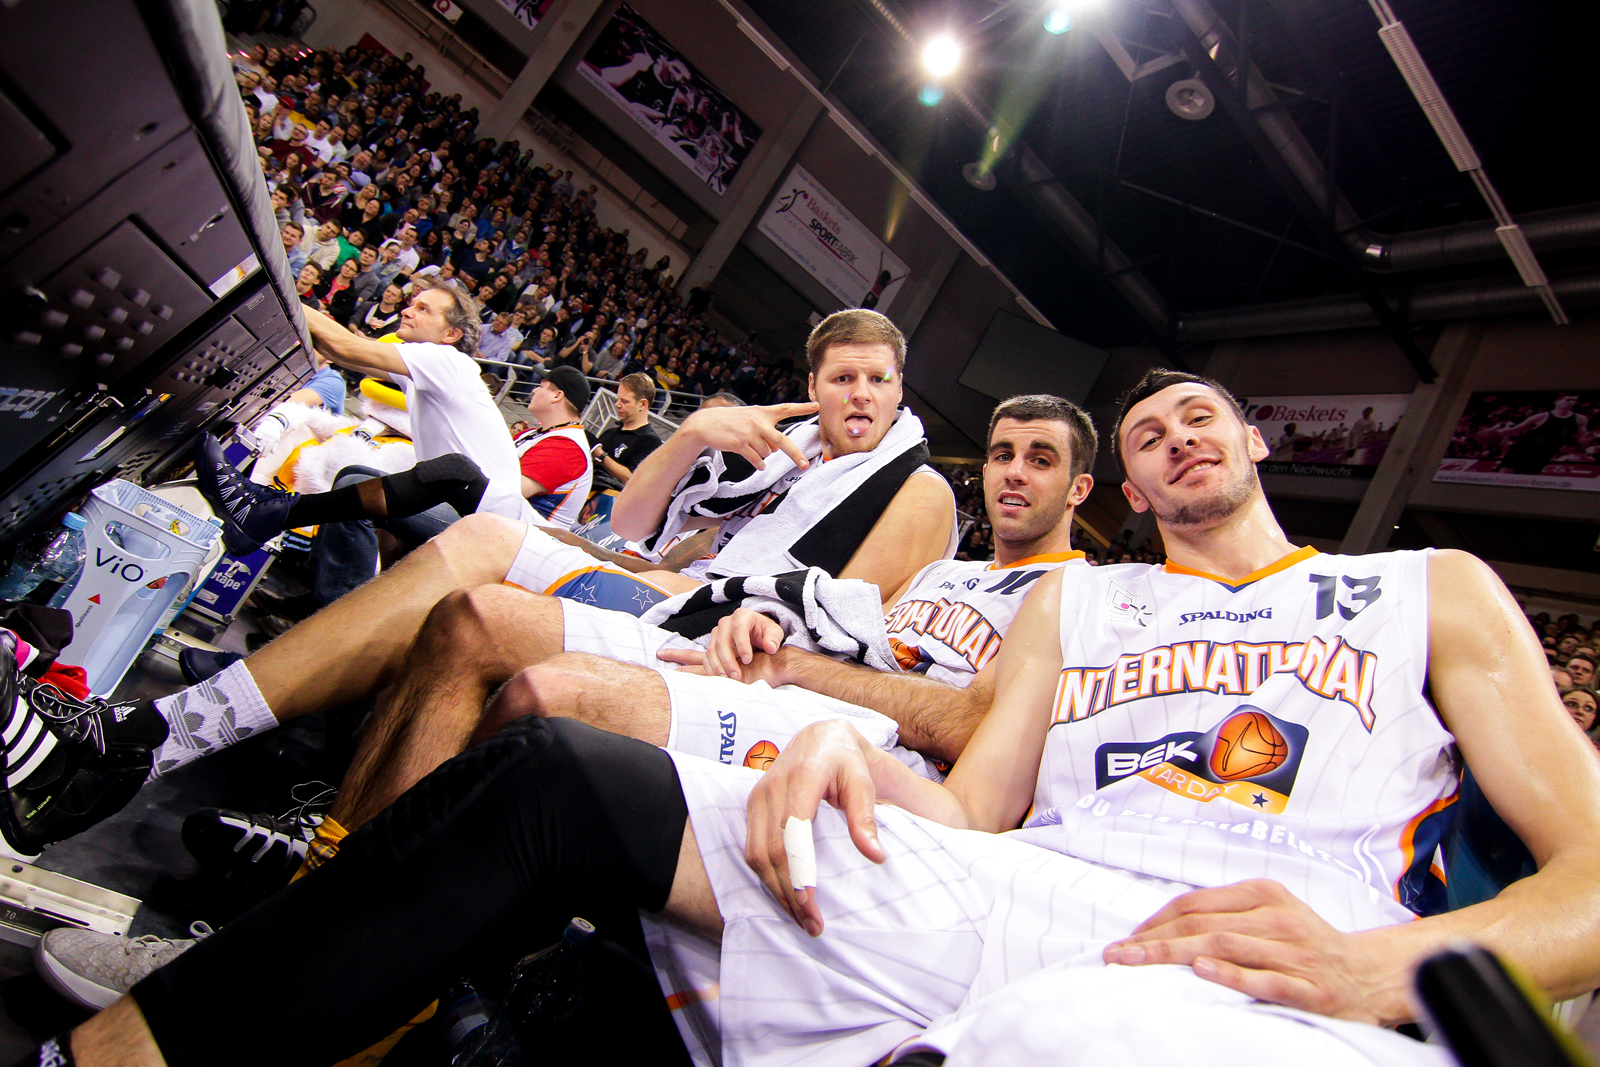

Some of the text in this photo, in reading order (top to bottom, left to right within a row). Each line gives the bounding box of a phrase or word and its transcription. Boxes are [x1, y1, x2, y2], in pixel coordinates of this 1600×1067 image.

[805, 197, 844, 235] Baskets
[807, 216, 859, 266] SPORTFABRIK
[1291, 464, 1352, 476] Nachwuchs
[95, 547, 144, 583] ViO
[1178, 607, 1273, 626] SPALDING
[1308, 573, 1383, 622] 13
[717, 710, 737, 765] SPAL
